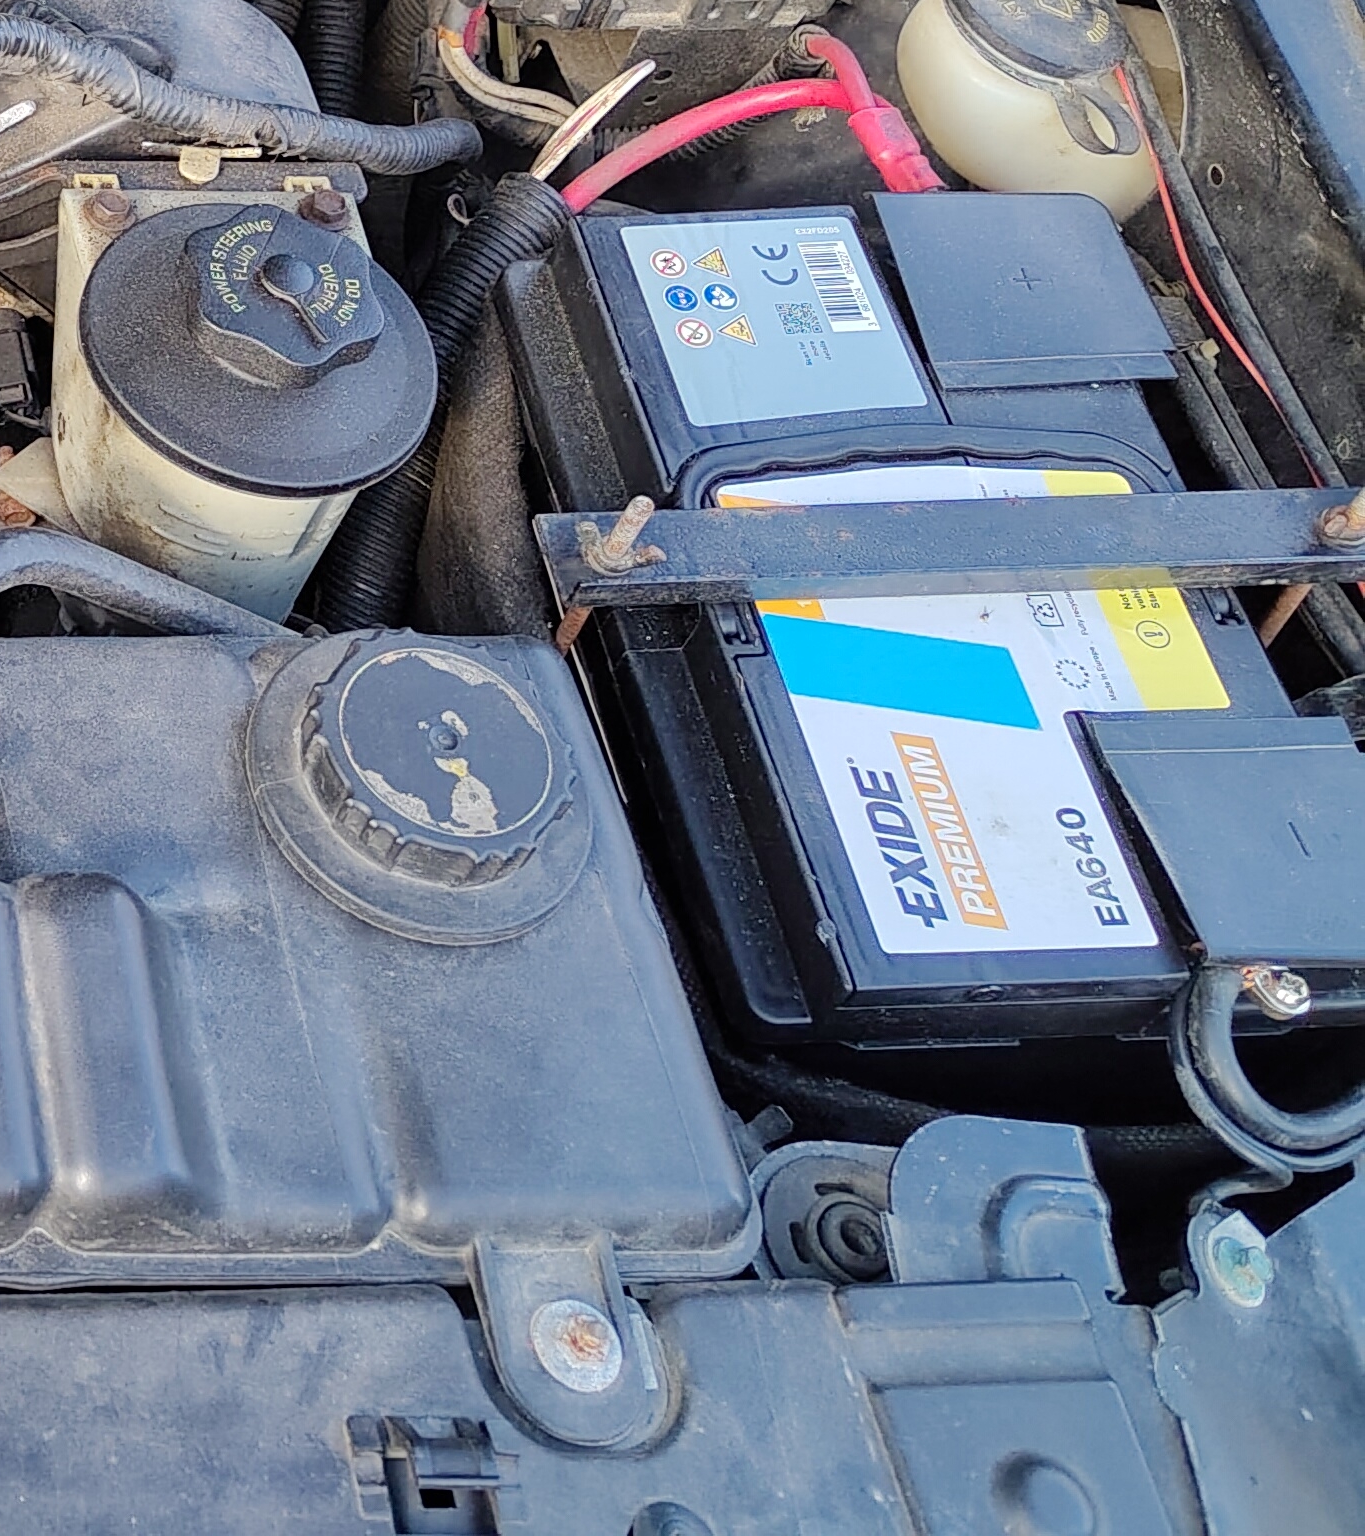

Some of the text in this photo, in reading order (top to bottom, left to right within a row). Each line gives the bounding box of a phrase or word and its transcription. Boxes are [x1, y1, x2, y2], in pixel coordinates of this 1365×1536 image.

[210, 219, 274, 314] POWER STEERING
[233, 244, 258, 281] FLUID
[334, 278, 361, 328] DO NOT
[1120, 594, 1133, 610] Not
[1089, 646, 1105, 672] Europe
[1104, 682, 1117, 702] Made
[849, 766, 949, 928] EXIDE
[901, 744, 997, 917] PREMIUM
[1055, 807, 1130, 927] EA640
